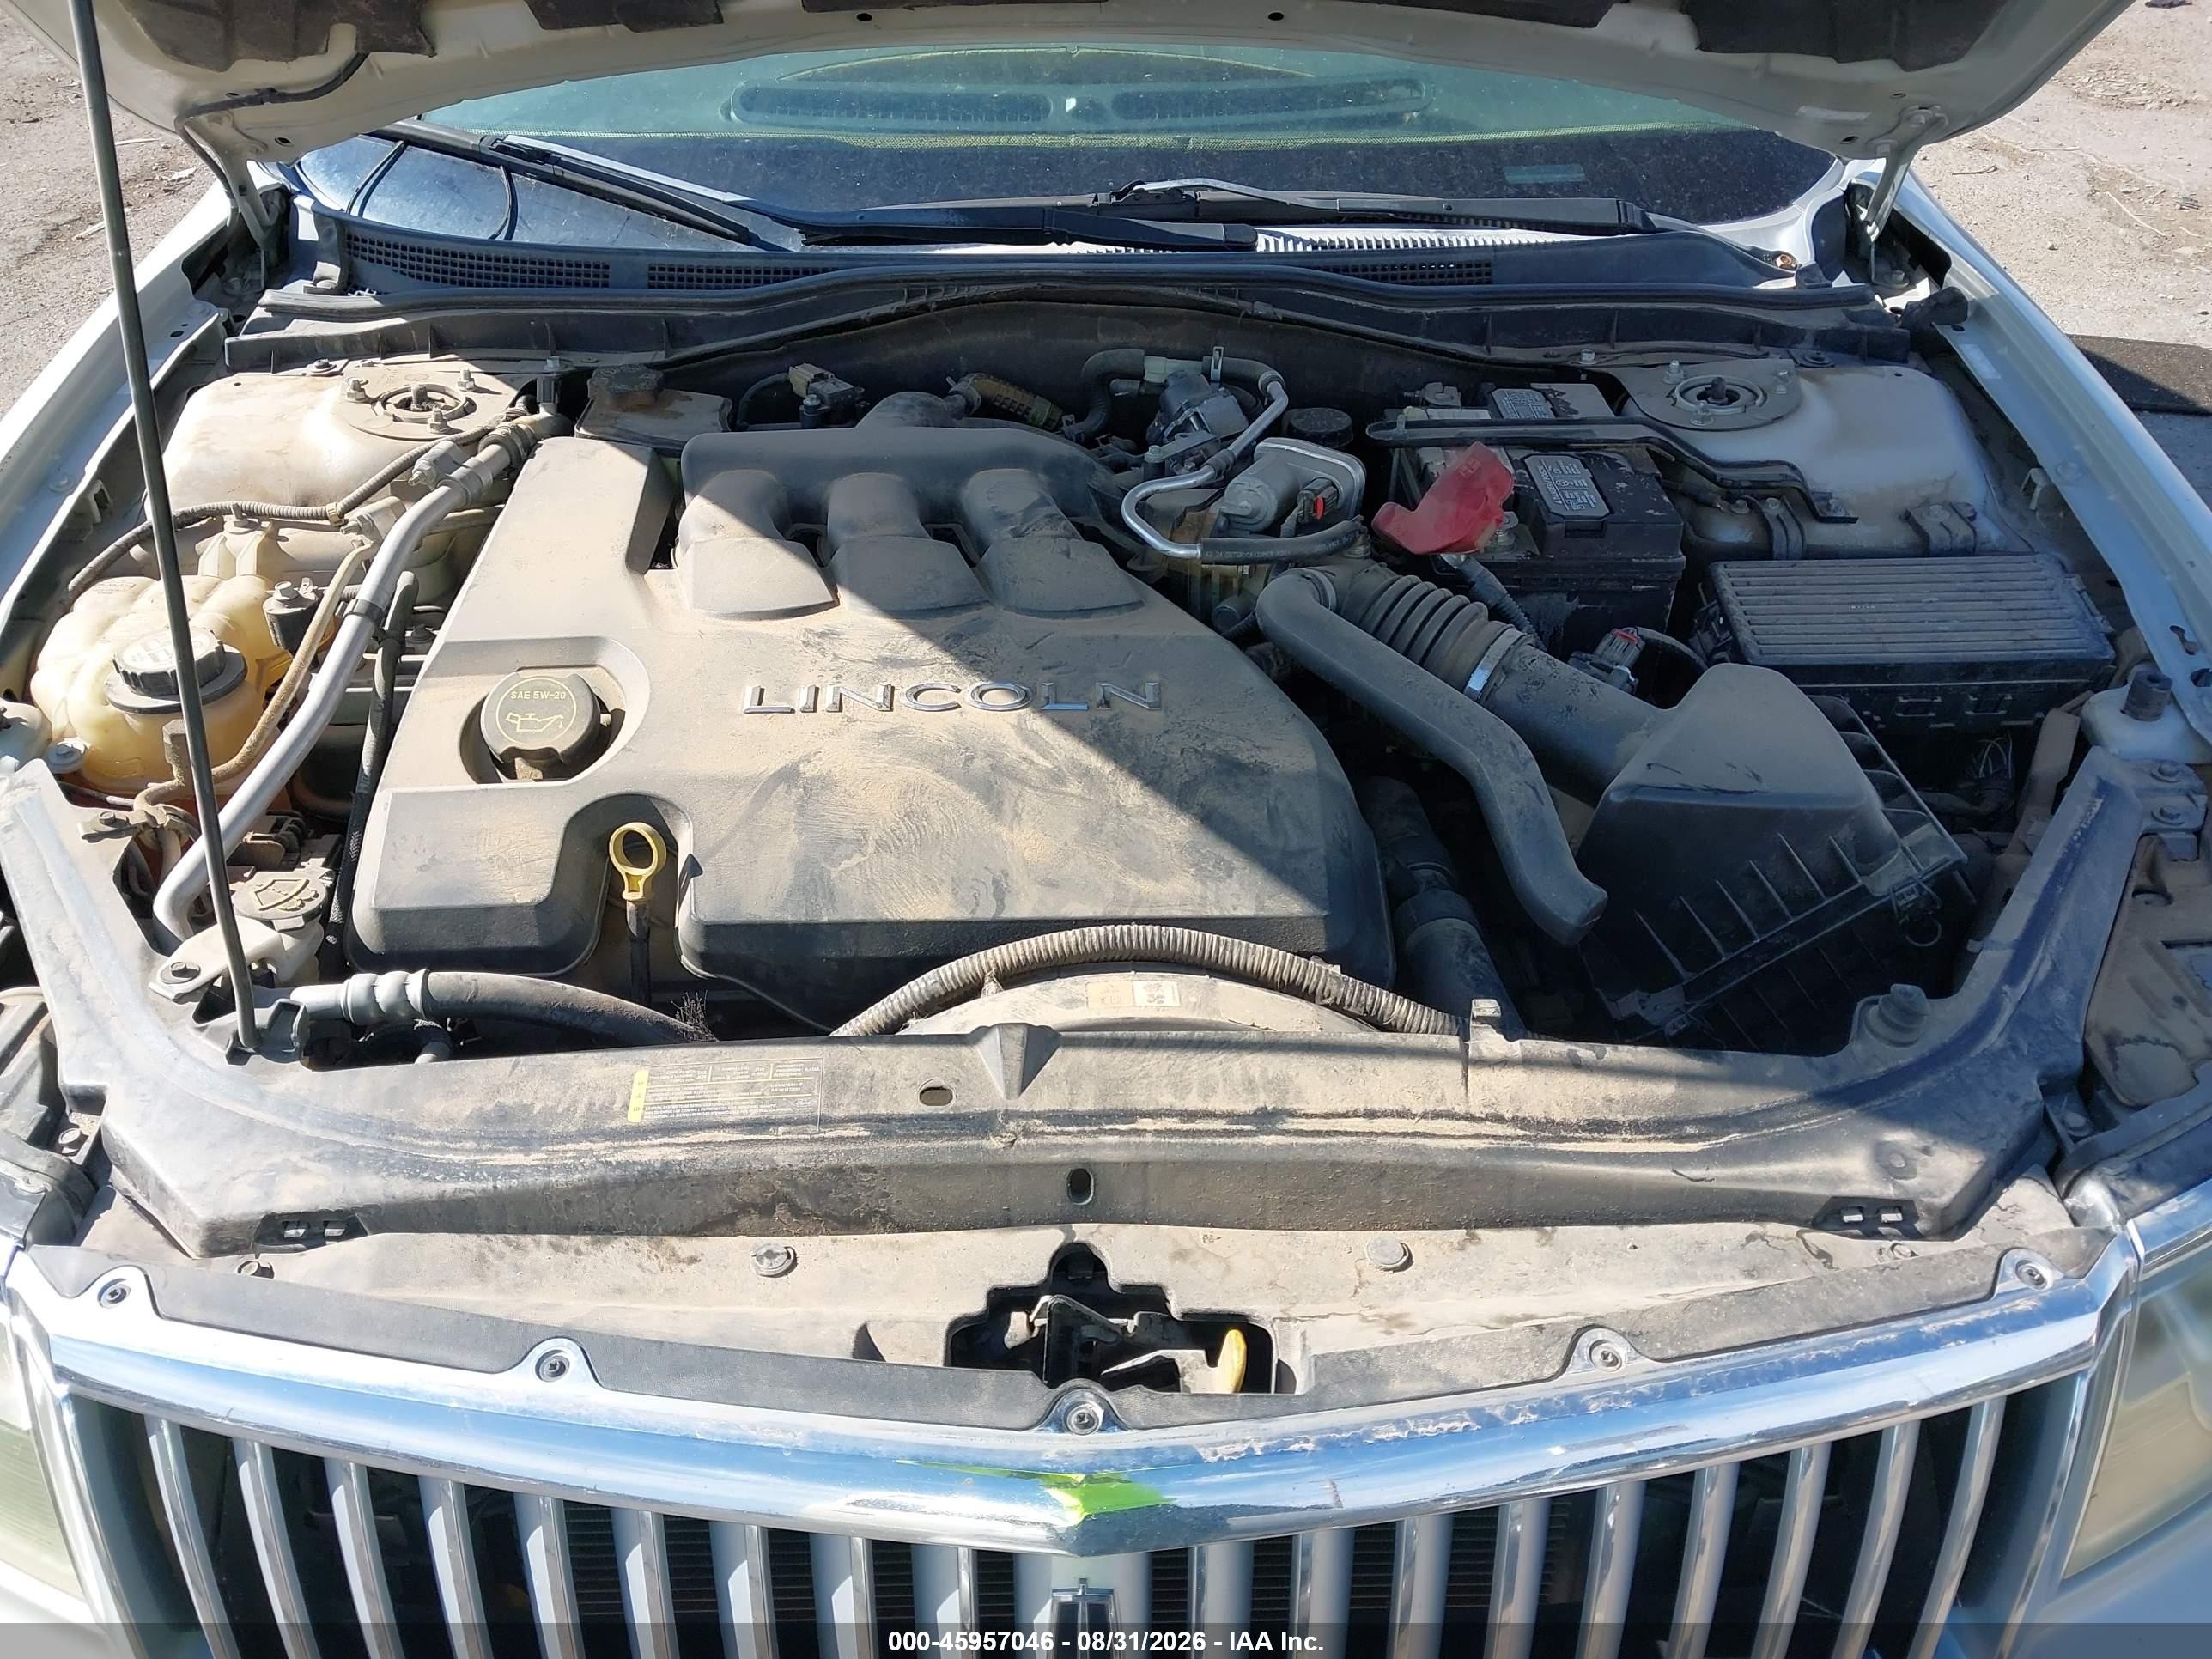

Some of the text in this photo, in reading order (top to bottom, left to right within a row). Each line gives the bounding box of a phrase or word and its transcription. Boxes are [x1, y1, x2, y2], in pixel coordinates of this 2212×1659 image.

[510, 690, 566, 700] SAE 5W-20
[743, 682, 1163, 714] LINCOLN
